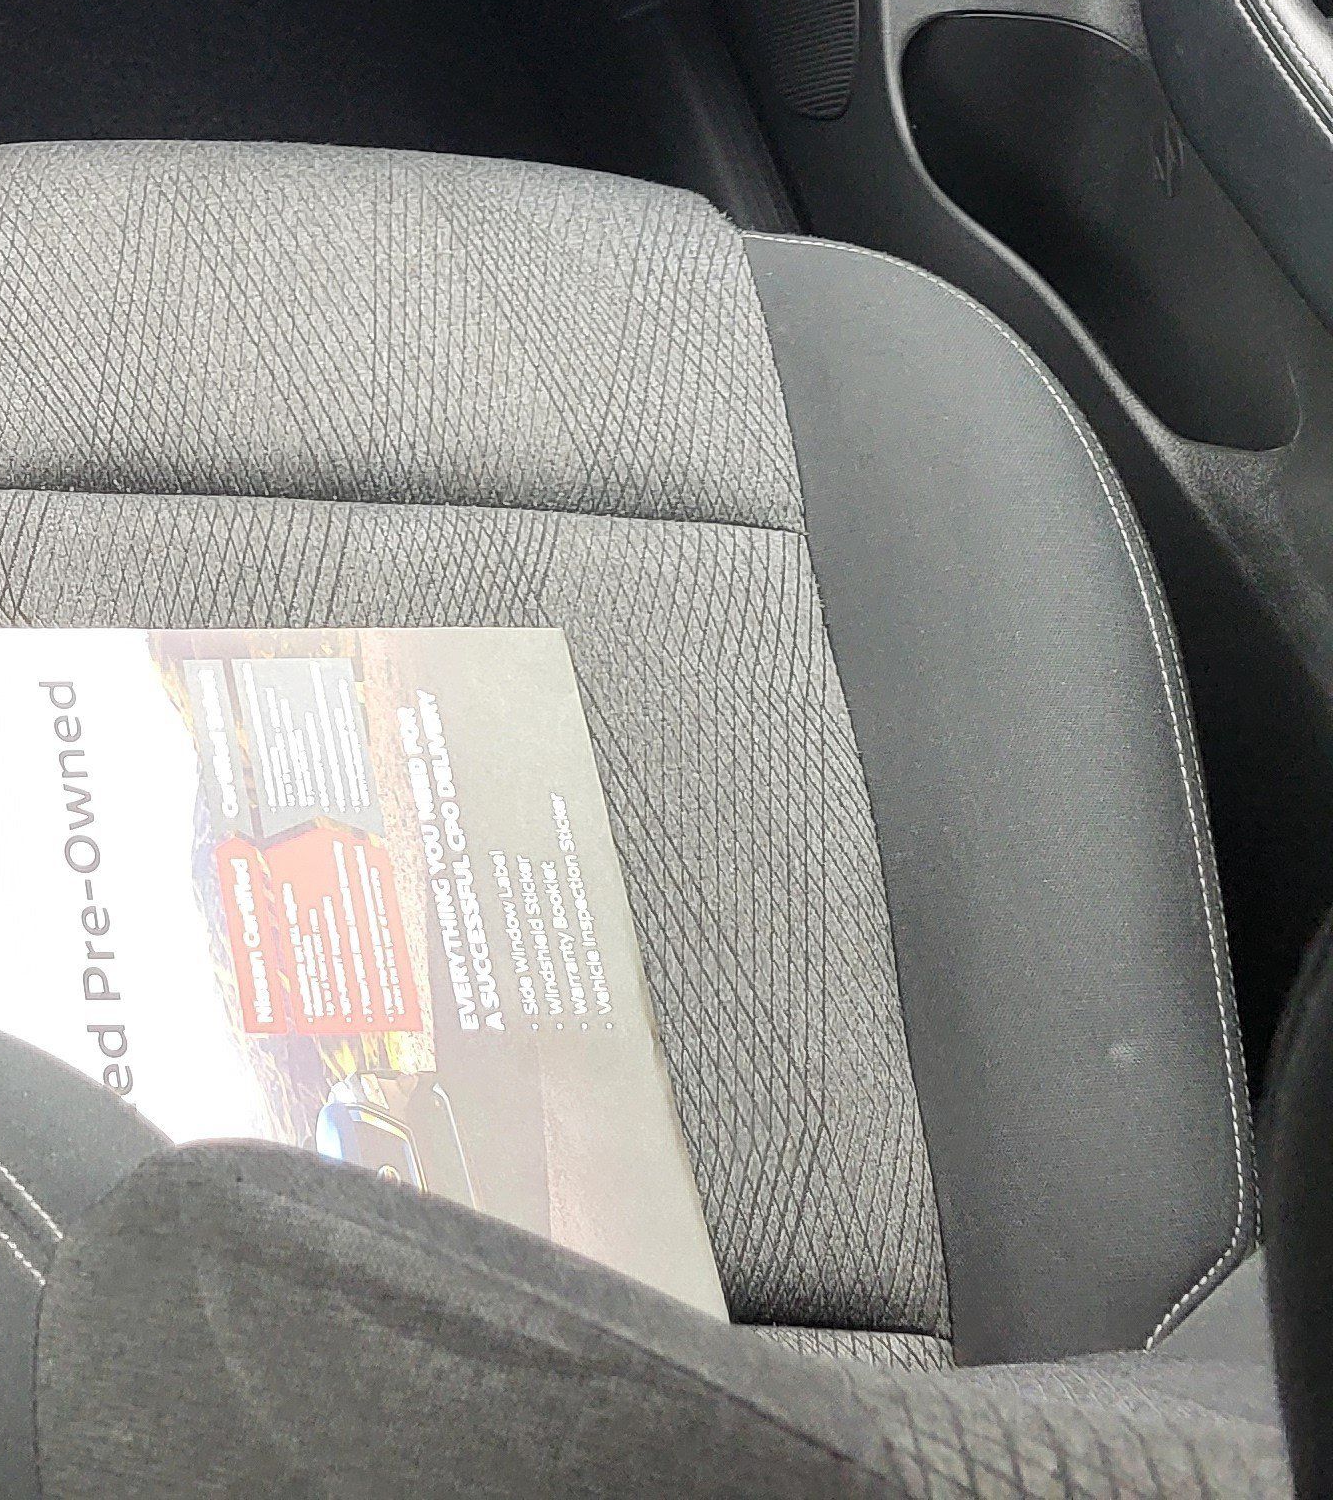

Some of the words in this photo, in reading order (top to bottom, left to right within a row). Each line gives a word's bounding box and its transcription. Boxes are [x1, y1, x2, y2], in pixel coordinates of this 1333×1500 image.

[397, 706, 424, 755] FOR
[416, 688, 457, 799] DELIVERY
[408, 757, 436, 822] NEED
[549, 791, 576, 853] Sticker
[38, 681, 121, 1001] Pre-Owned
[422, 822, 447, 876] YOU
[442, 800, 468, 852] CPO
[229, 857, 262, 948] Certified
[488, 849, 513, 899] Label
[517, 854, 542, 915] Sticker
[541, 860, 569, 930] Booklet
[564, 853, 598, 948] Inspection
[431, 878, 479, 1031] EVERYTHING
[452, 854, 500, 1010] SUCCESSFUL
[503, 900, 531, 974] Window
[530, 916, 564, 1016] Windshield
[248, 950, 274, 1024] Nissan
[519, 983, 539, 1016] Side
[558, 931, 588, 1016] Warranty
[585, 949, 613, 1016] Vehicle
[485, 1011, 506, 1032] A
